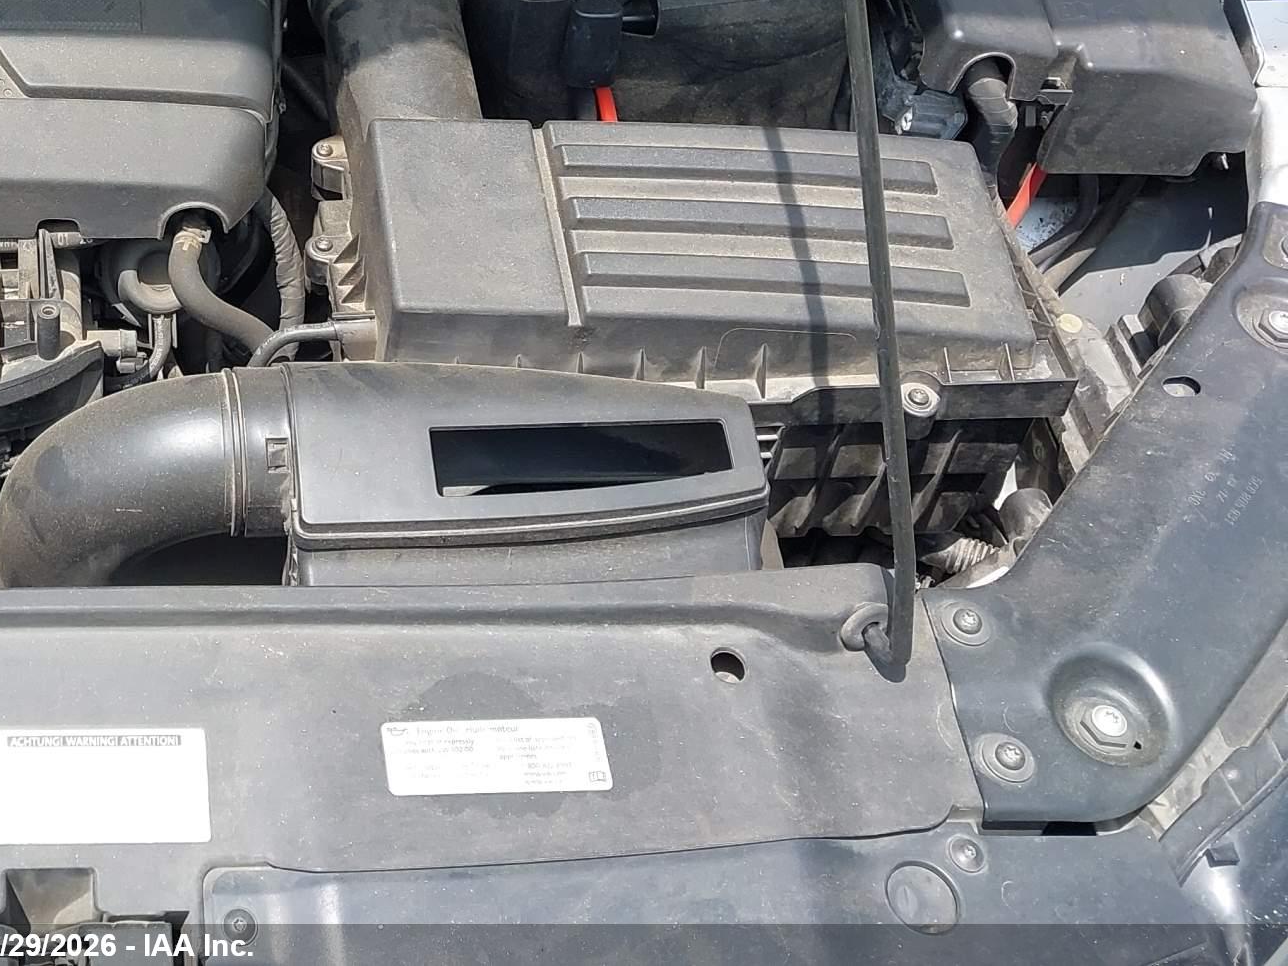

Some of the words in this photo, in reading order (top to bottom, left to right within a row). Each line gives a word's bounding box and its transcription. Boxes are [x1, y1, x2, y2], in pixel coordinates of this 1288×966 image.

[10, 735, 63, 747] ACHTUNG!
[65, 735, 118, 747] WARNING!
[120, 735, 179, 747] ATTENTION!
